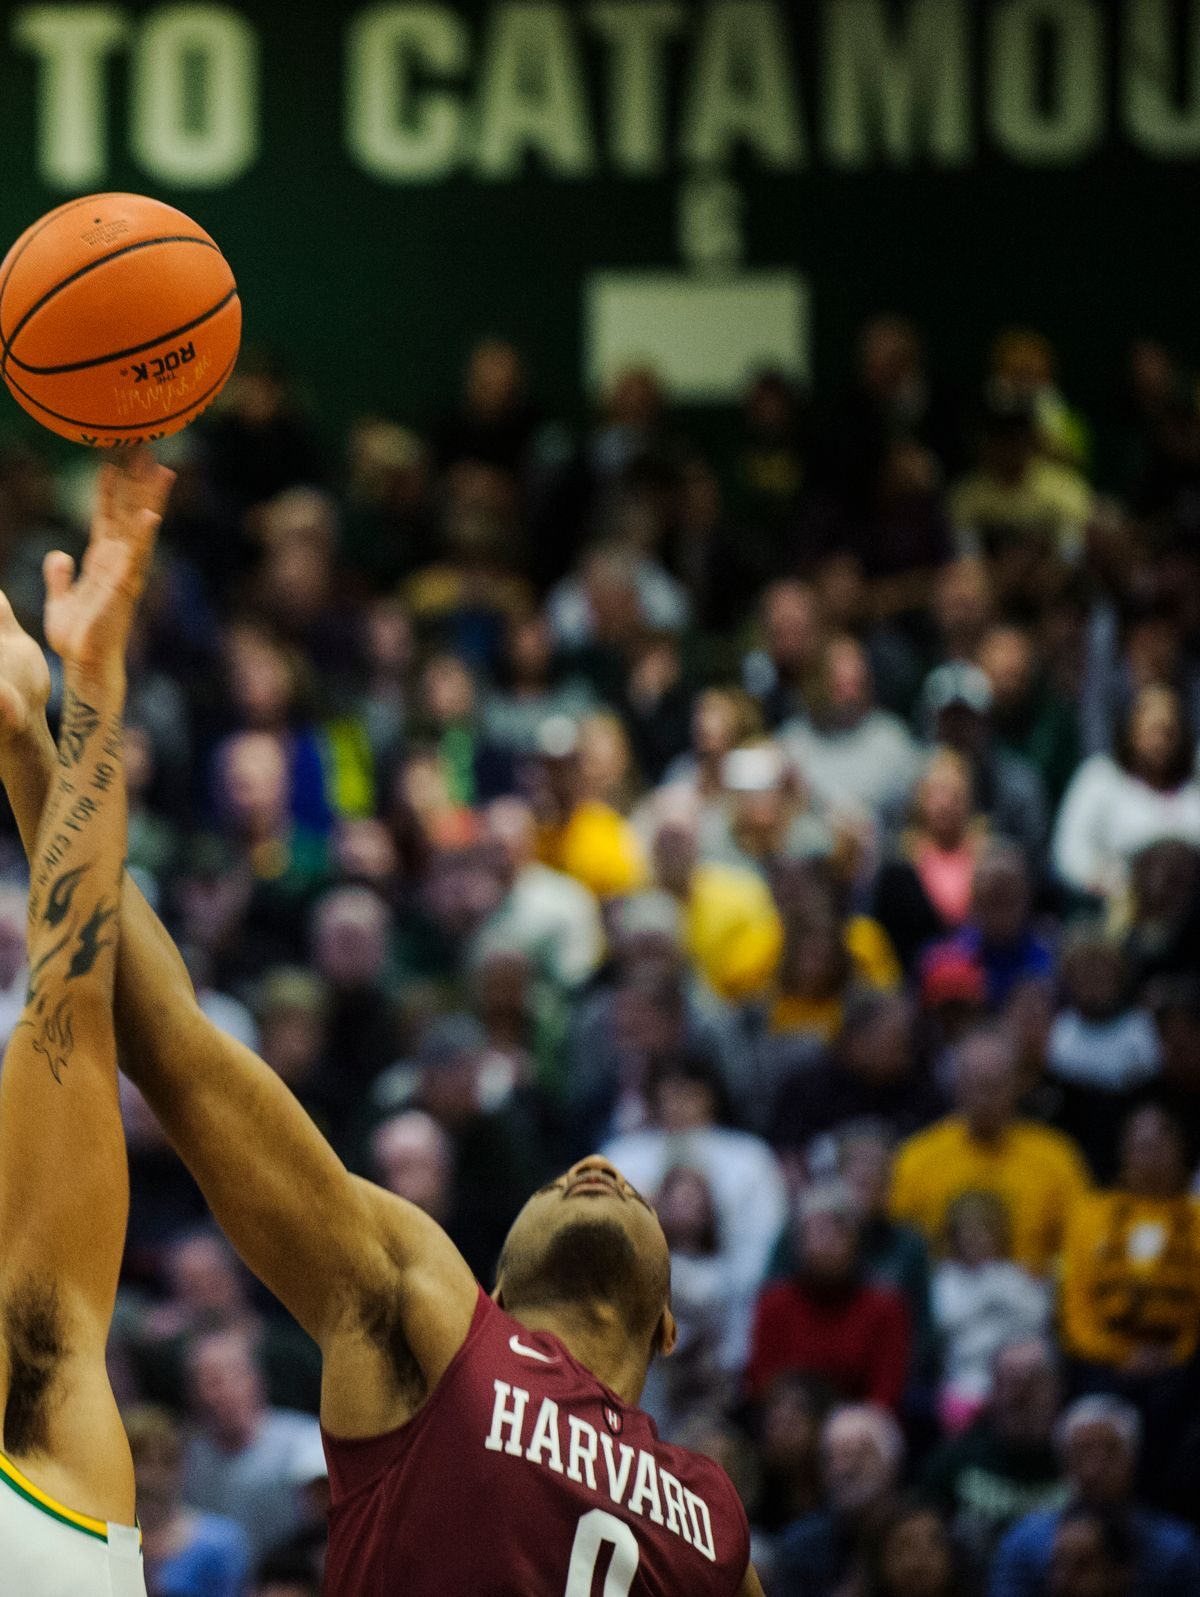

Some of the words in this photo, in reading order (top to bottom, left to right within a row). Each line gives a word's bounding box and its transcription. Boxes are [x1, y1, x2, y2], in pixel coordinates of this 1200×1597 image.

[17, 5, 258, 191] TO
[129, 341, 196, 383] ROCK
[484, 1378, 717, 1563] HARVARD
[608, 1406, 620, 1430] H
